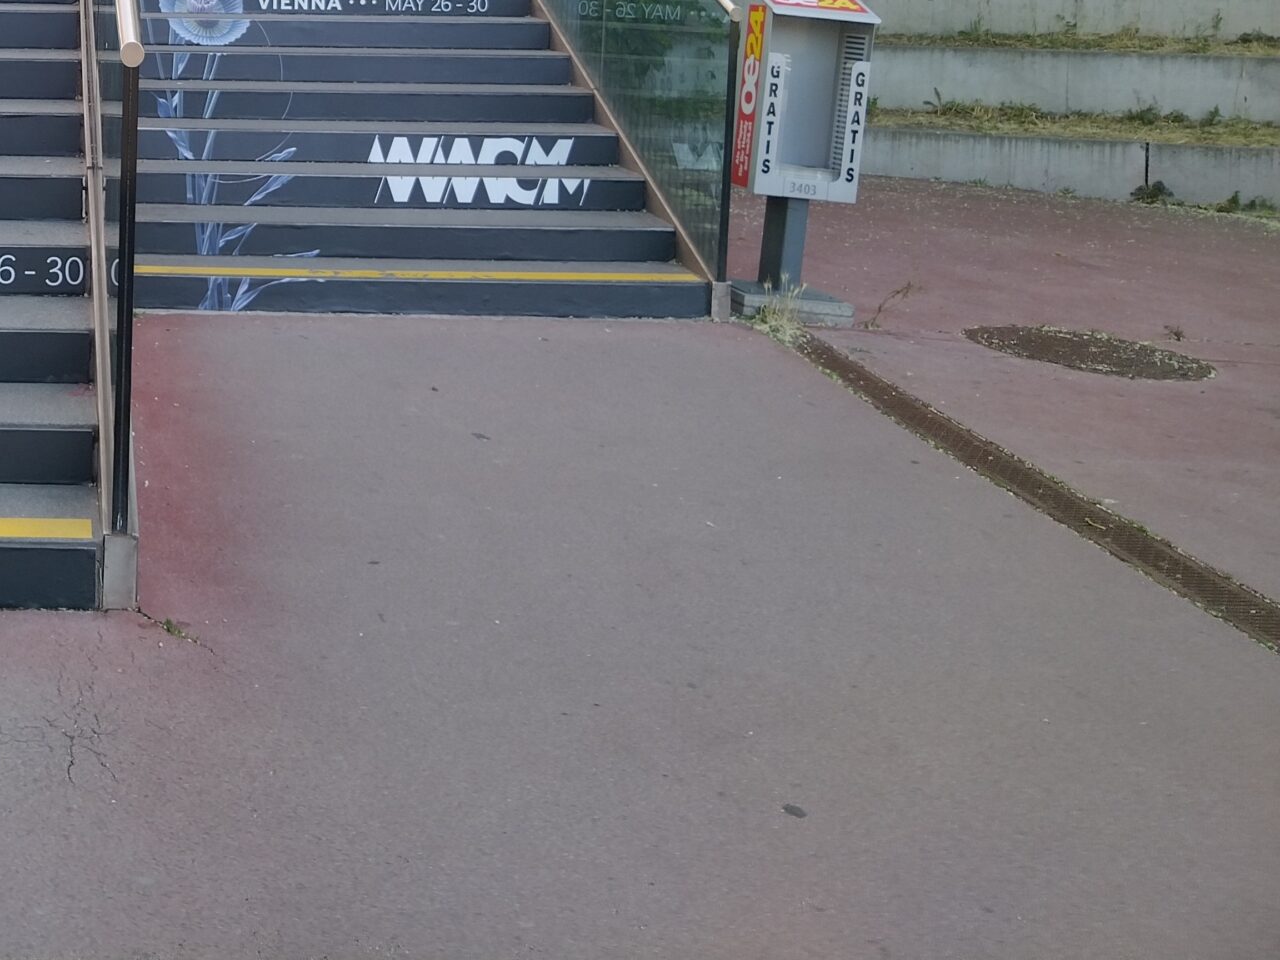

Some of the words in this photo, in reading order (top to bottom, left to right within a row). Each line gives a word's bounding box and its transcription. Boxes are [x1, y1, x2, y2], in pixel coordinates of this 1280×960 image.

[761, 65, 781, 174] GRATIS
[845, 72, 866, 183] GRATIS
[789, 182, 817, 196] 3403
[45, 256, 84, 287] 30
